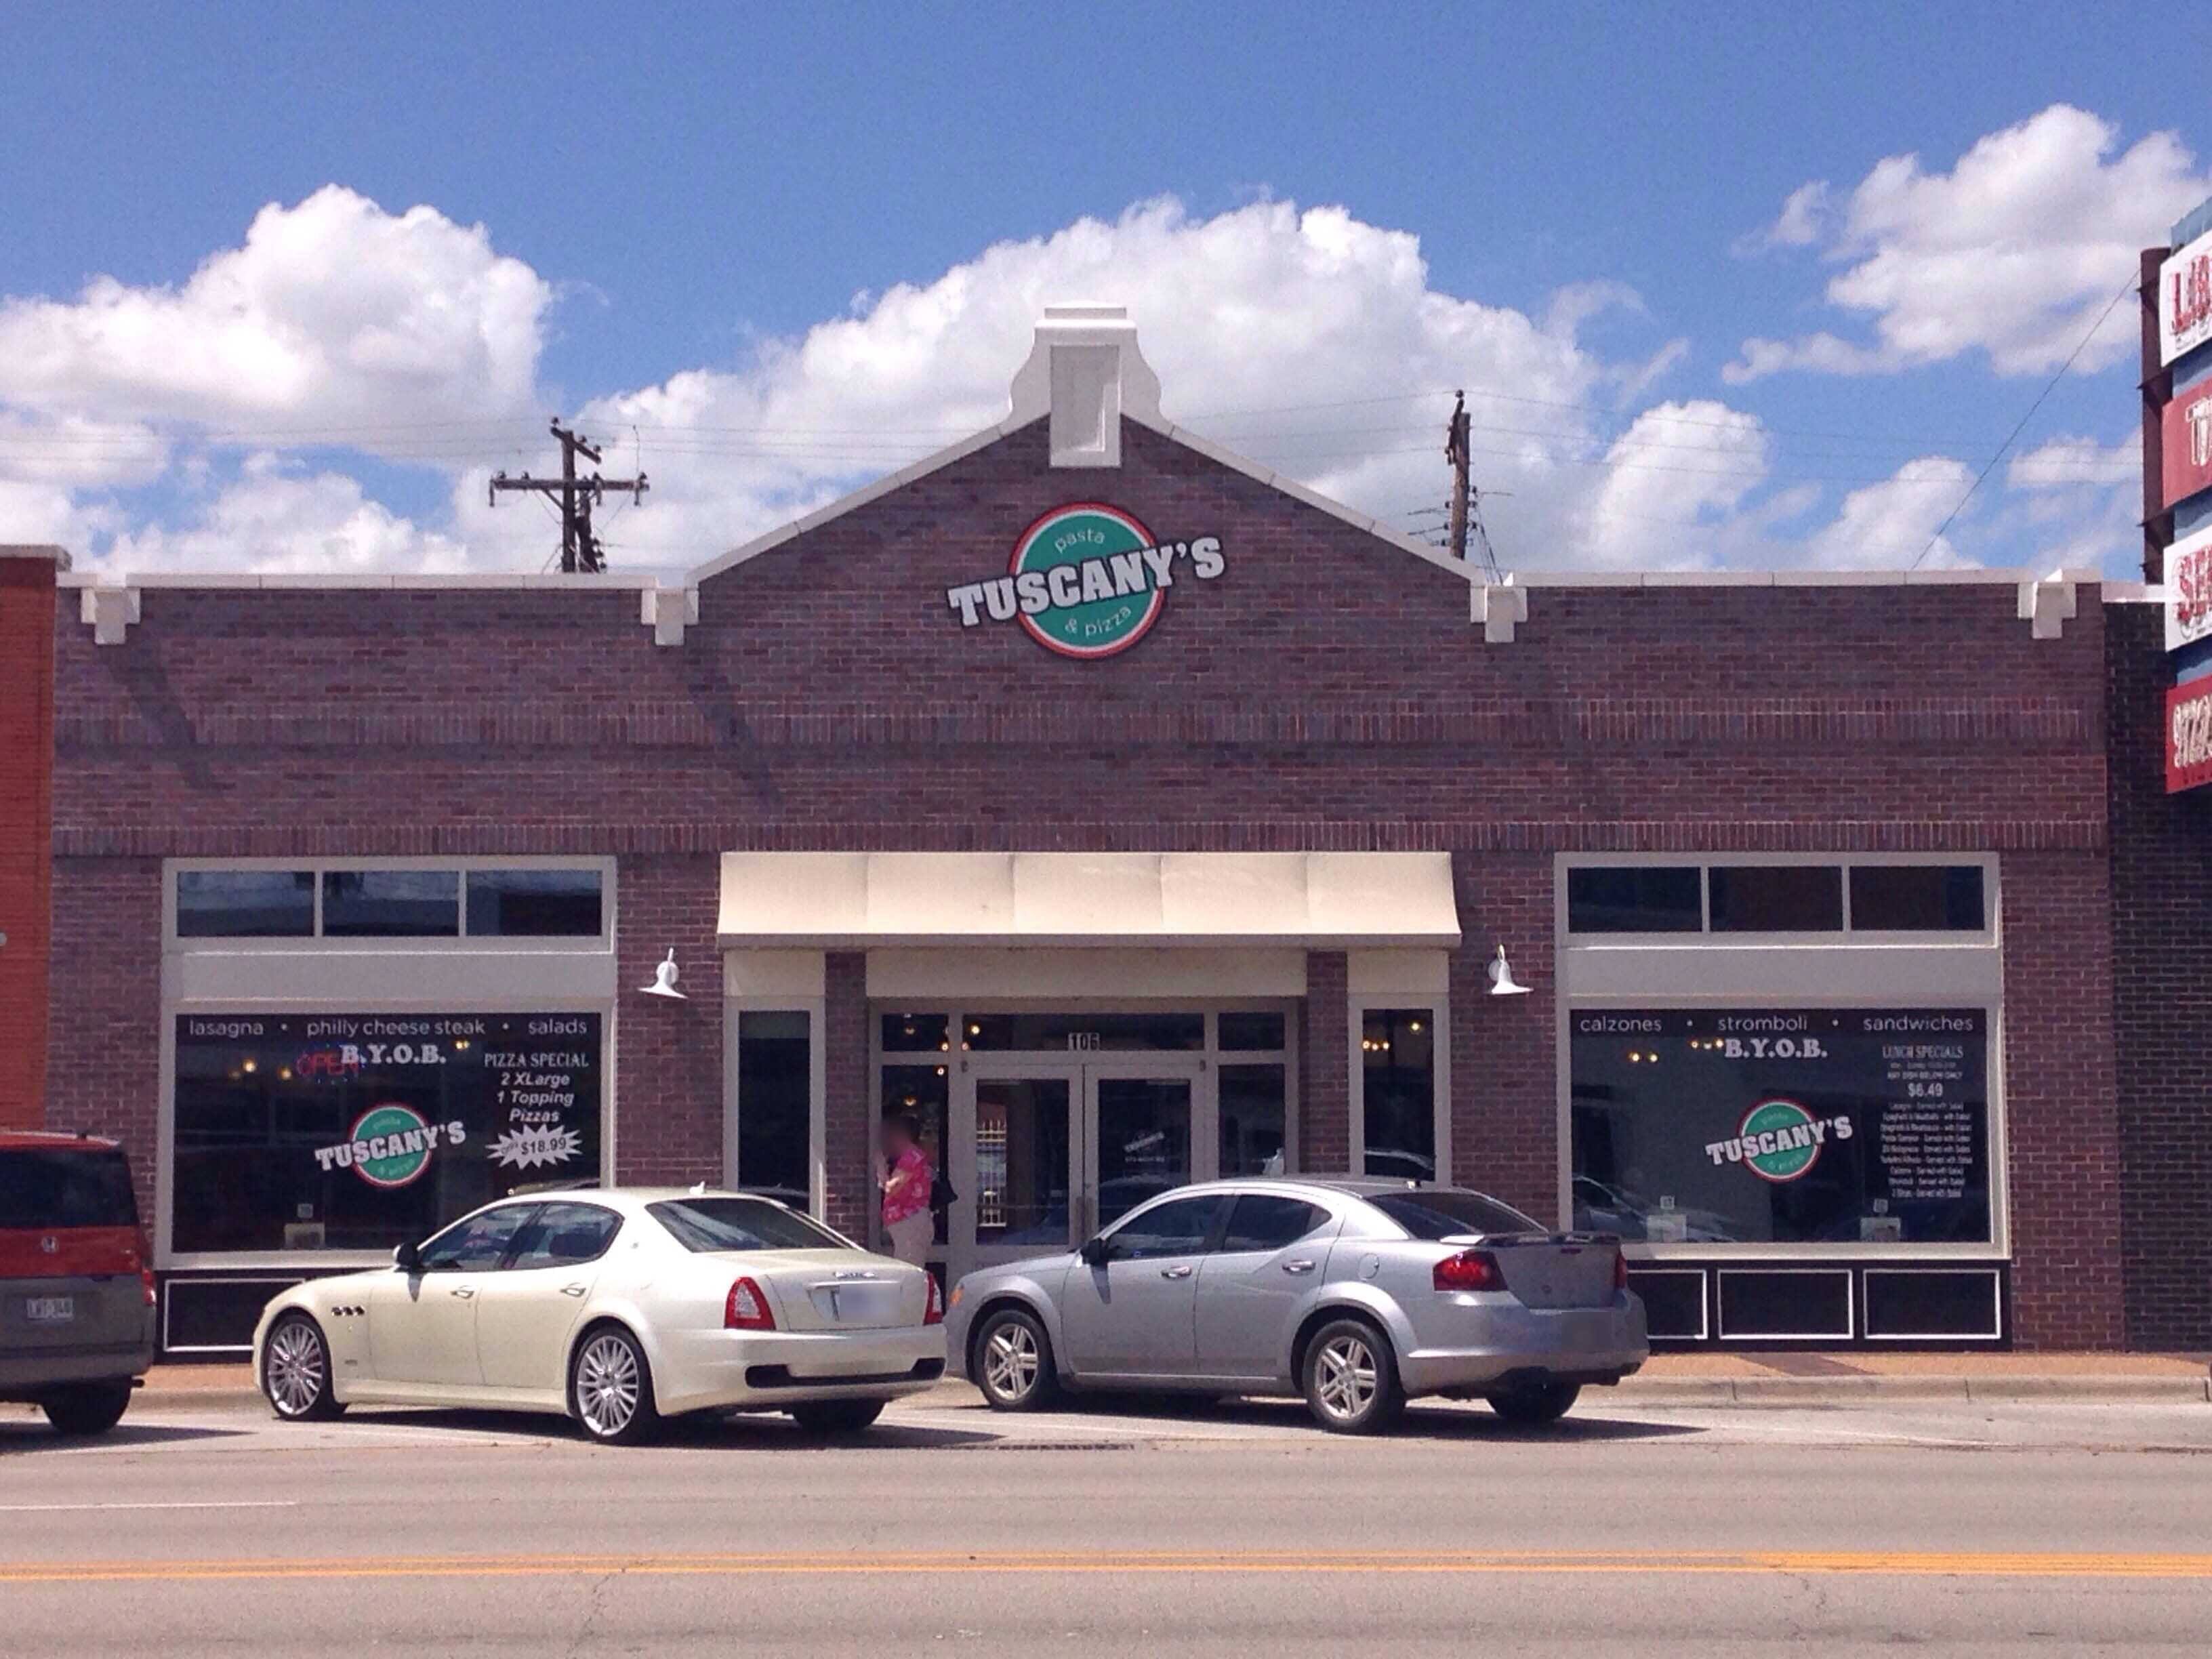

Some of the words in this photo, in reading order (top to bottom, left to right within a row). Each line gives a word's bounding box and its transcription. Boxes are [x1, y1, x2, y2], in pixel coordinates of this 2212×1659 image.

[1054, 529, 1105, 553] pasta
[947, 537, 1225, 627] TUSCANY'S
[1065, 618, 1078, 634] &
[1086, 607, 1131, 638] pizza
[189, 1019, 264, 1038] lasagna
[307, 1019, 359, 1038] philly
[363, 1019, 429, 1035] cheese
[434, 1019, 485, 1034] steak
[528, 1018, 588, 1034] salads
[1580, 1016, 1662, 1031] calzones
[1718, 1016, 1807, 1031] stromboli
[1864, 1015, 1973, 1031] sandwiches
[1071, 1033, 1099, 1051] 106
[1725, 1038, 1828, 1058] B.Y.O.B.
[339, 1043, 447, 1064] B.Y.O.B.
[485, 1053, 527, 1067] PIZZA
[531, 1052, 589, 1067] SPECIAL
[501, 1072, 510, 1086] 2
[514, 1071, 570, 1088] XLarge
[497, 1090, 505, 1104] 1
[510, 1090, 575, 1107] Topping
[509, 1107, 560, 1122] Pizzas
[315, 1121, 466, 1170] TUSCANY'S
[521, 1137, 567, 1155] $18.99
[1705, 1116, 1853, 1165] TUSCANY'S
